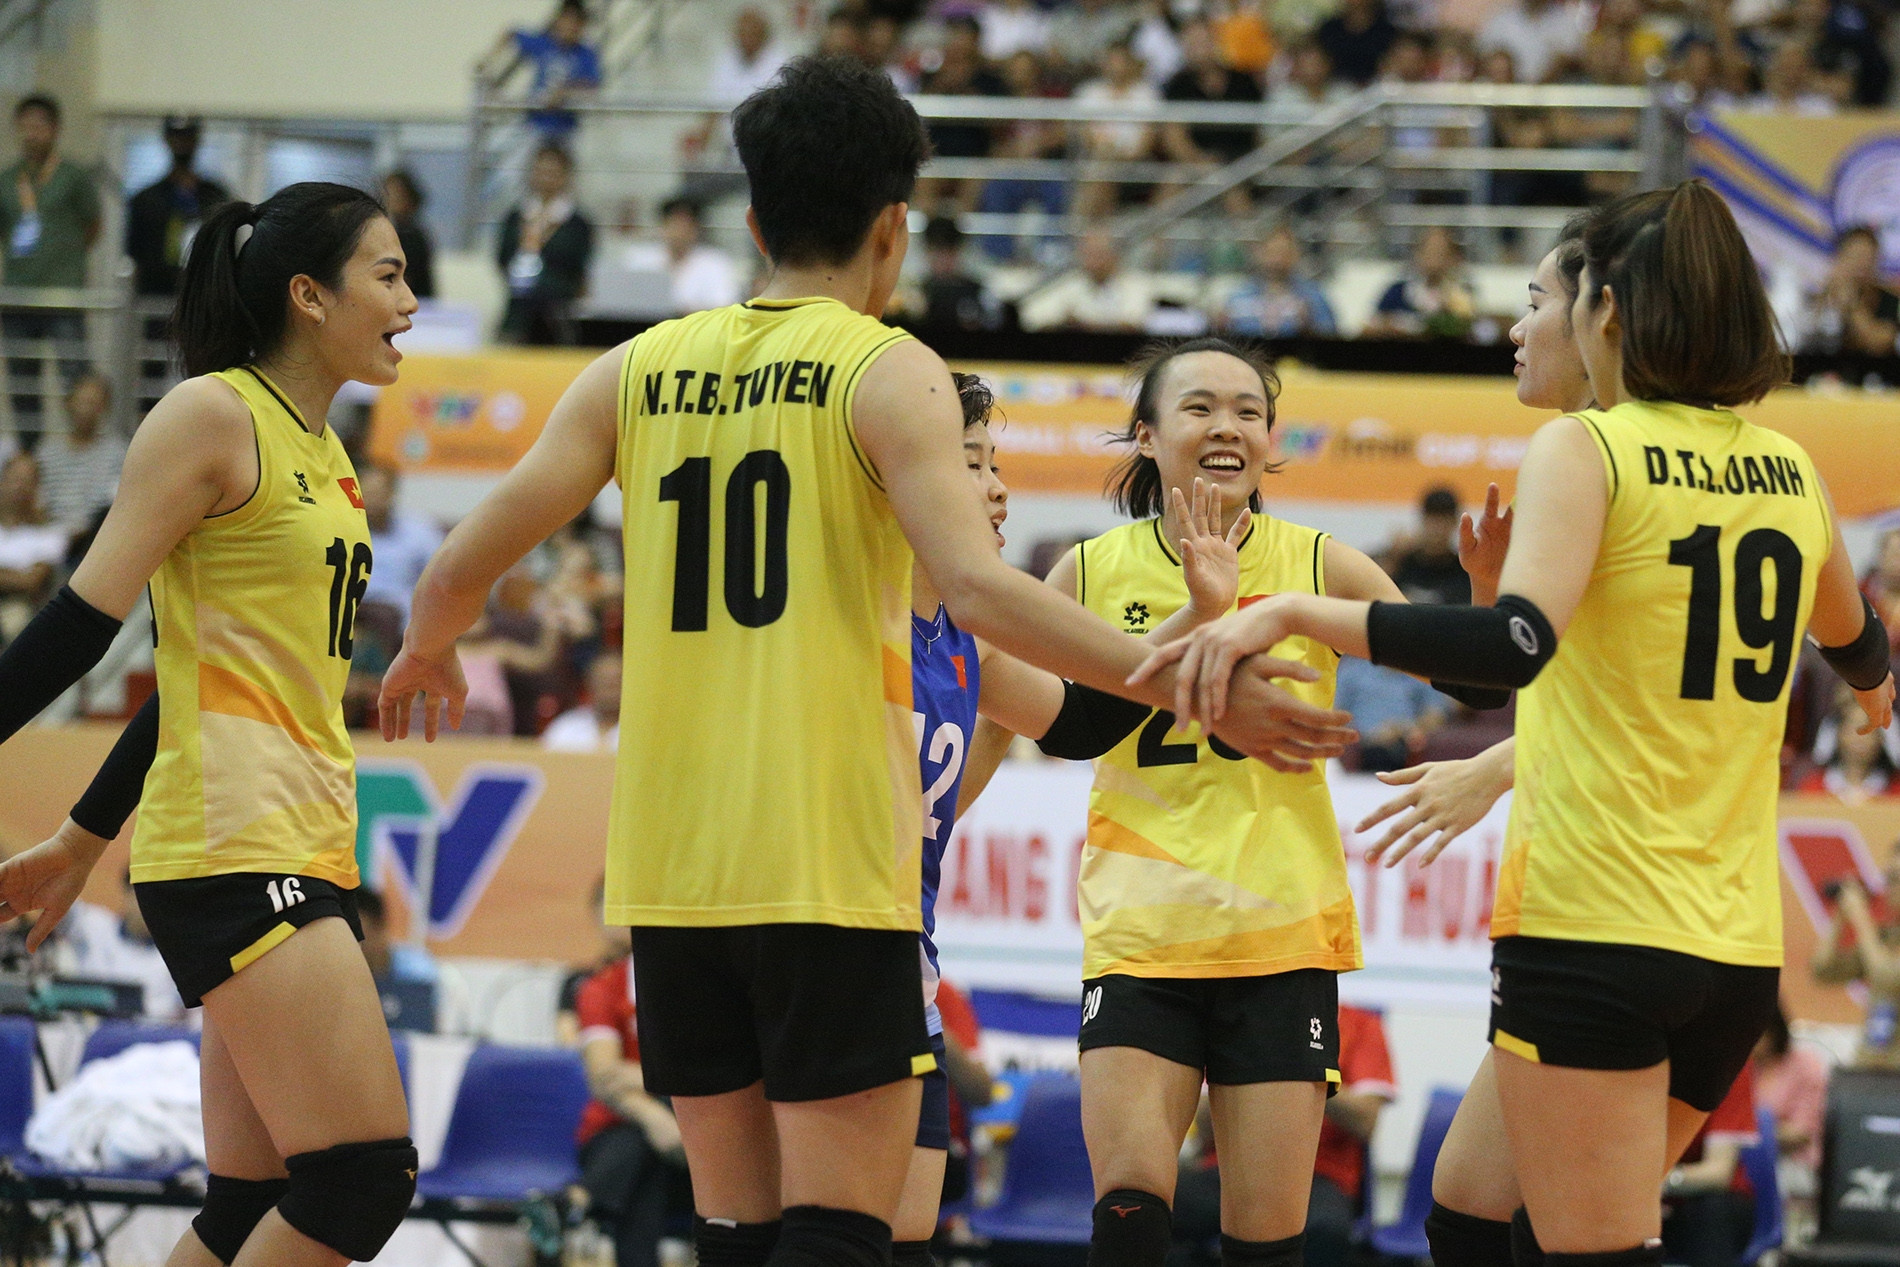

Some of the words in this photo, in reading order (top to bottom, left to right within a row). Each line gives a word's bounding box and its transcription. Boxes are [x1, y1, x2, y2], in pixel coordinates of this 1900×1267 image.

[639, 359, 836, 417] N.T.B.TUYEN
[1643, 445, 1806, 498] D.T.L.OANH
[658, 449, 791, 632] 10
[325, 536, 373, 660] 16
[1667, 523, 1803, 703] 19
[266, 876, 306, 914] 16
[1082, 985, 1103, 1026] 20
